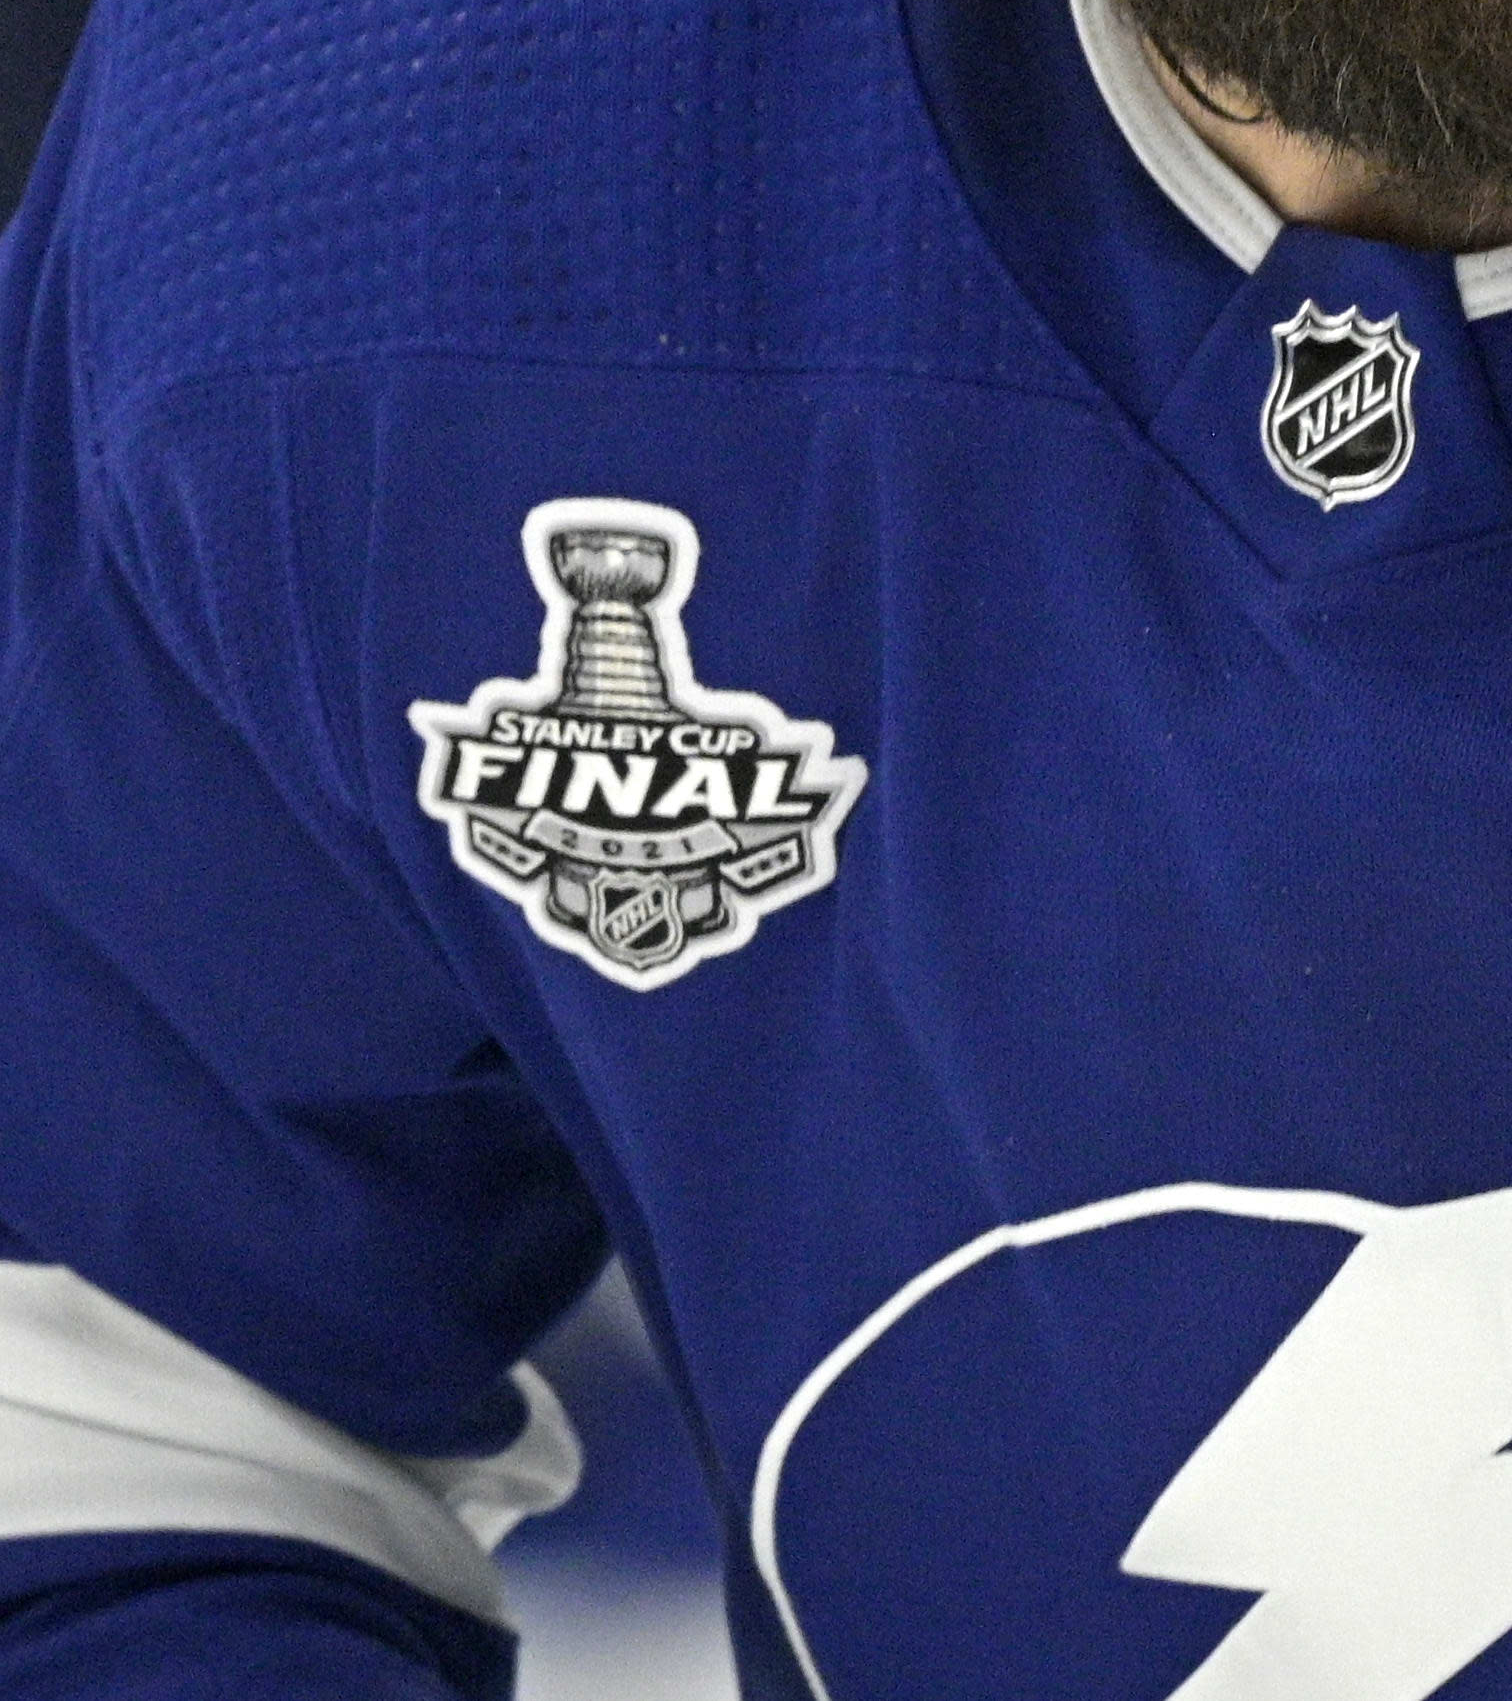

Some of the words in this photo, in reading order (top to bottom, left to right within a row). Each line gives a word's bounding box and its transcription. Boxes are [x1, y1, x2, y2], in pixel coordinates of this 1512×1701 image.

[1296, 362, 1386, 455] NHL
[491, 711, 663, 751] STANLEY
[669, 724, 756, 755] CUP
[451, 740, 813, 819] FINAL
[561, 828, 692, 859] 2021
[605, 890, 664, 942] NHL
